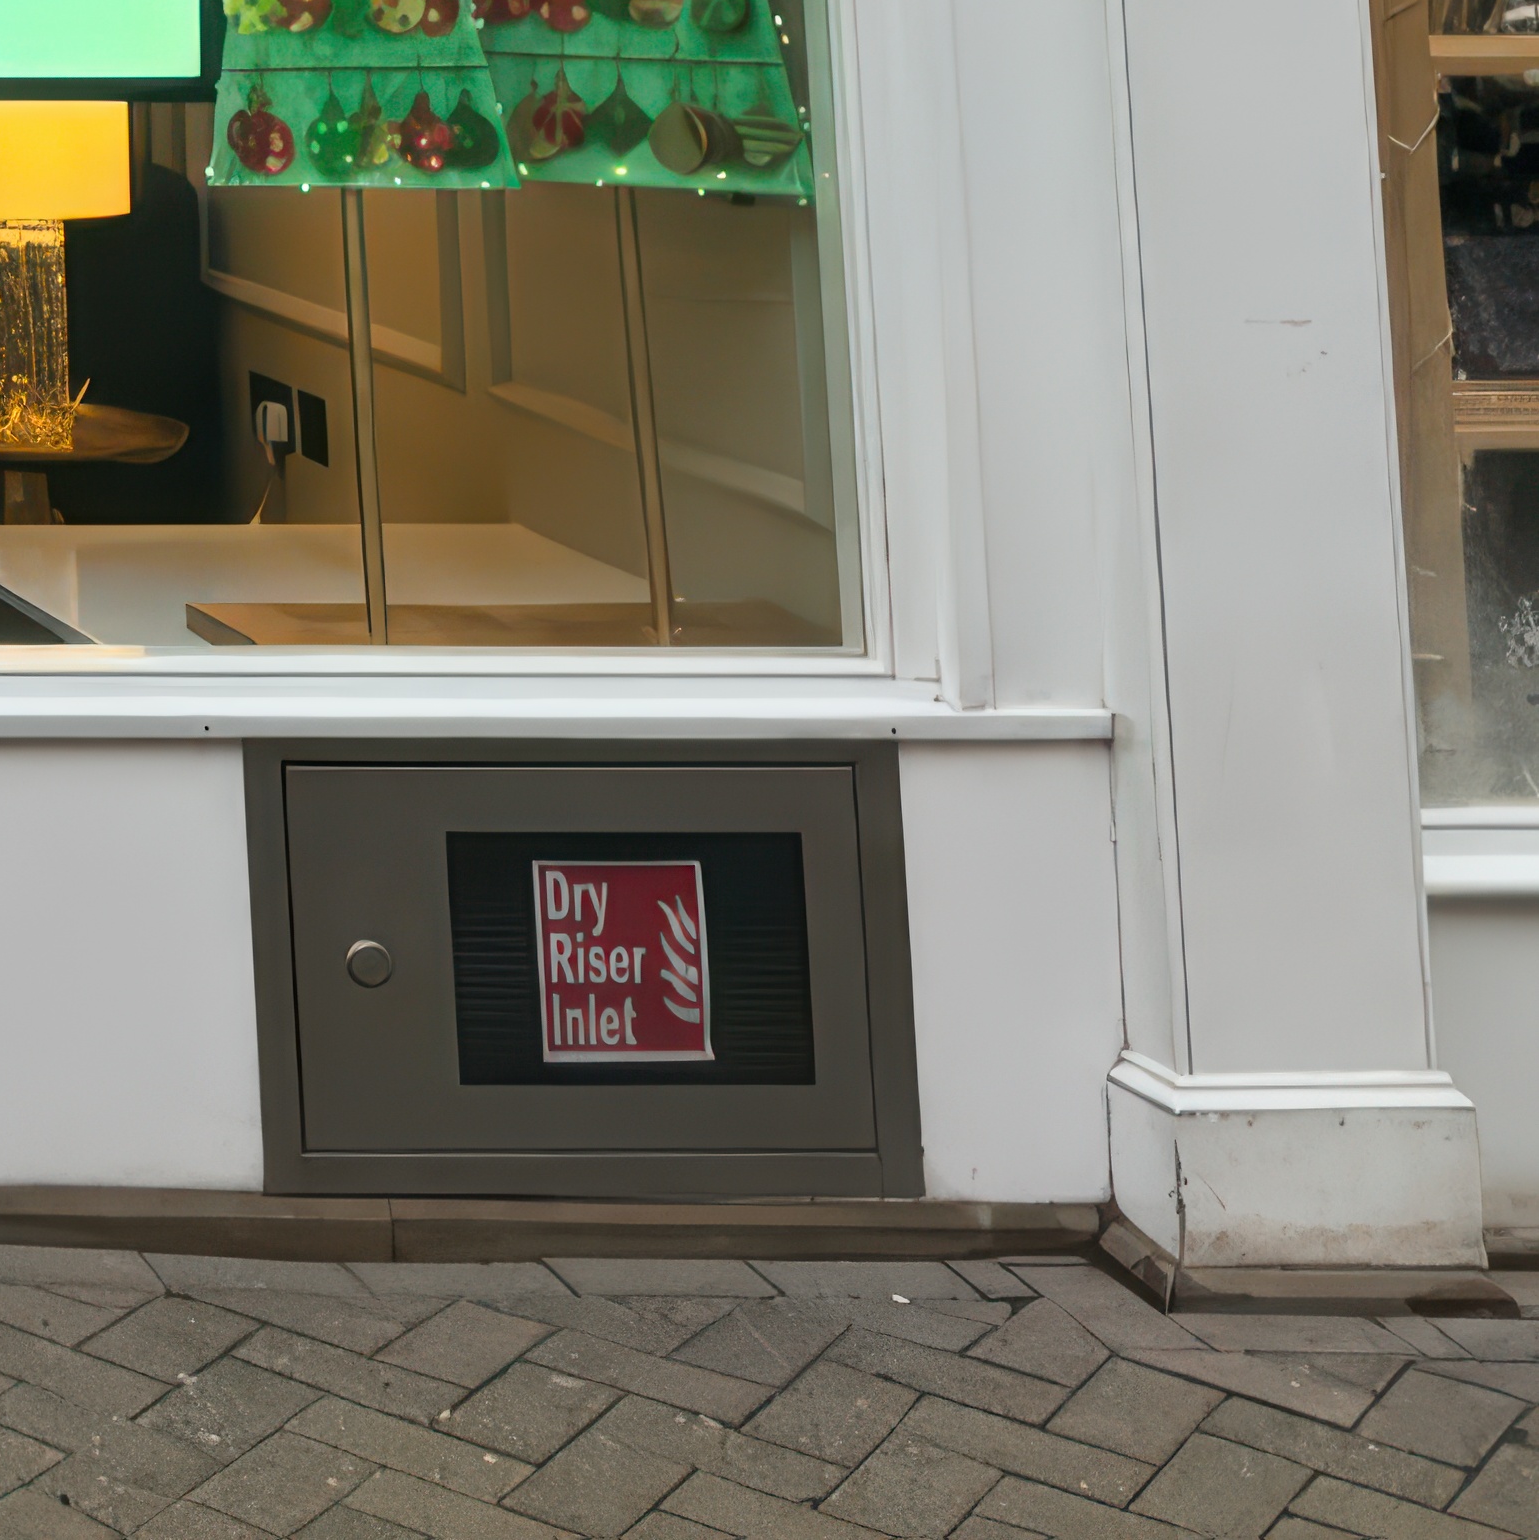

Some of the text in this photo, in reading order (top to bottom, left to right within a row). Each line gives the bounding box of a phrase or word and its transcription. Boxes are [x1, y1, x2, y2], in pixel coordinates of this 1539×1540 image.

[544, 870, 608, 937] Dry
[549, 931, 647, 985] Riser
[551, 992, 638, 1046] Inlet
